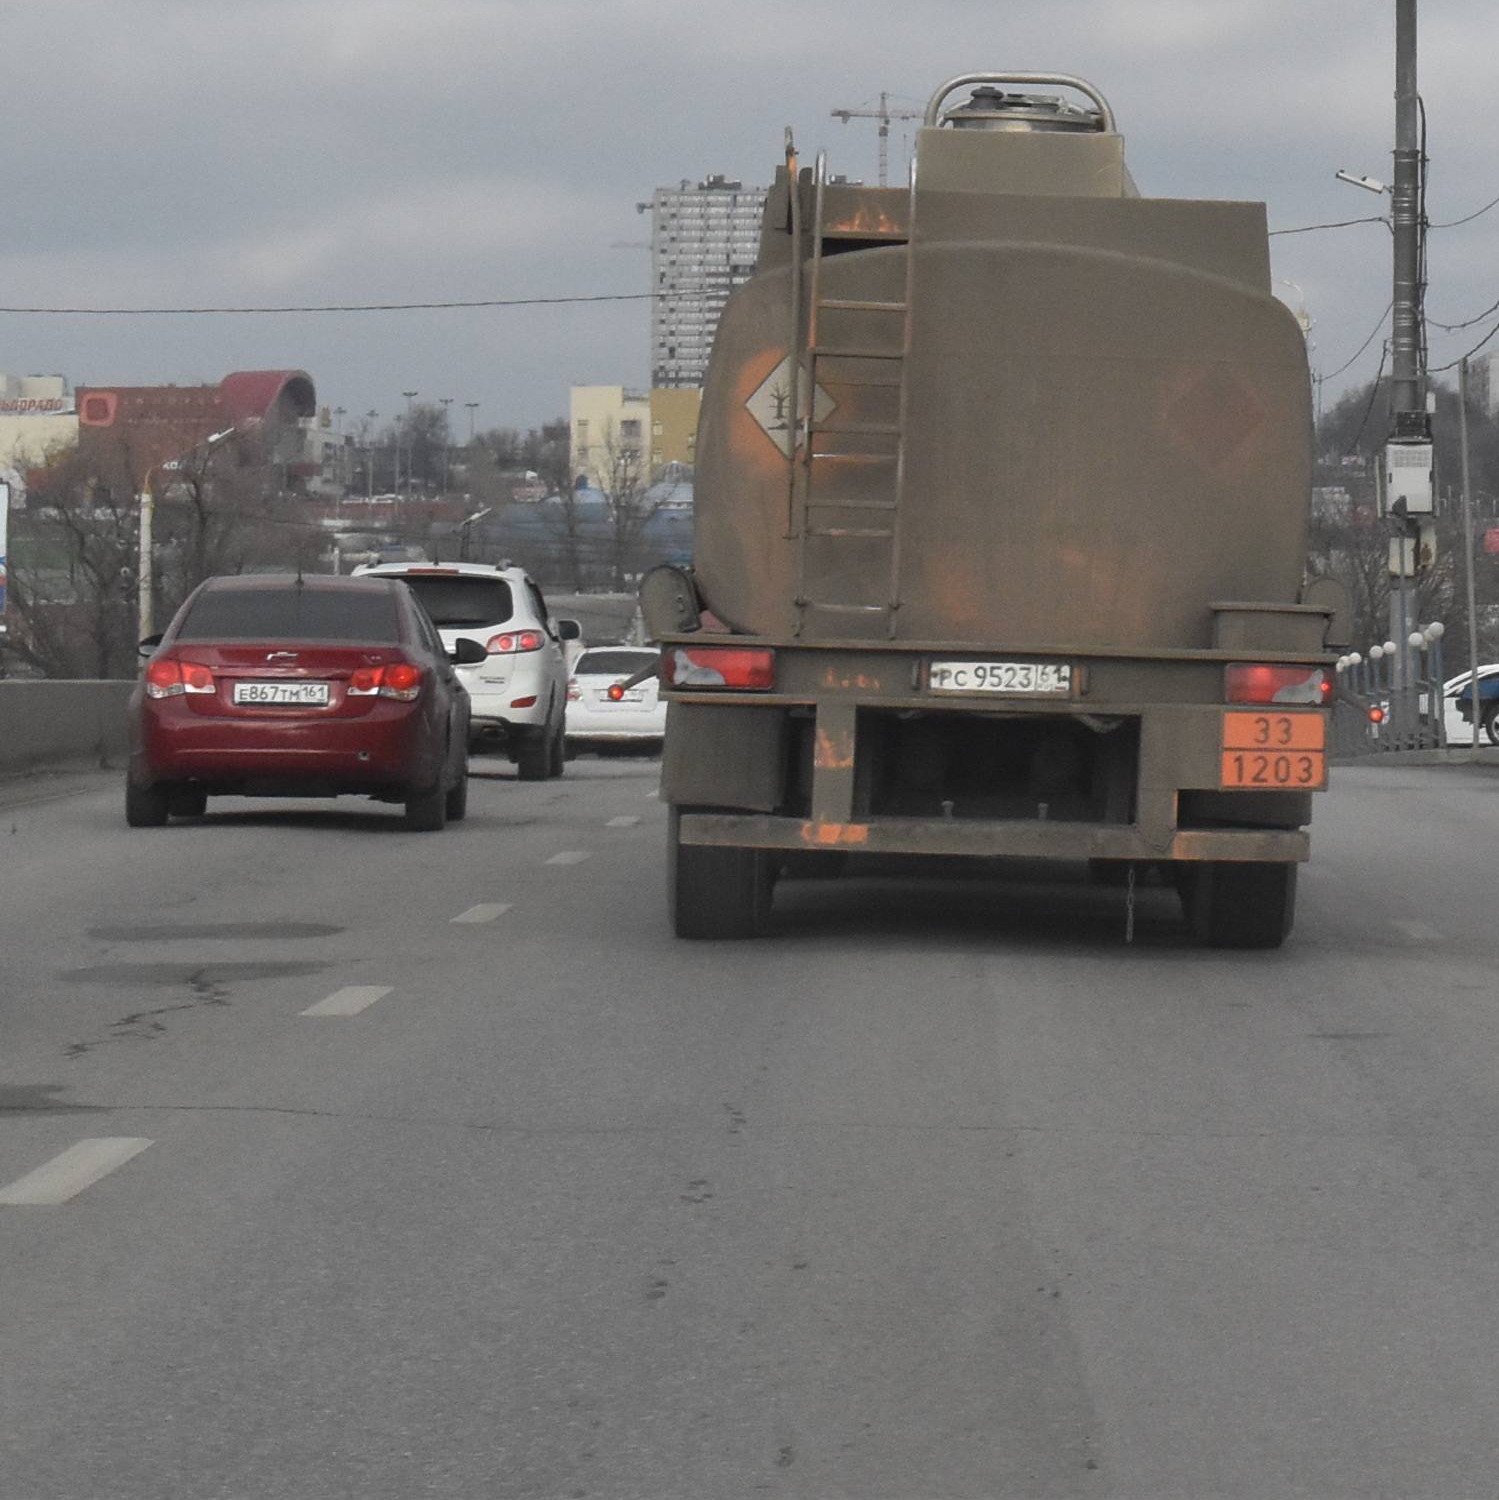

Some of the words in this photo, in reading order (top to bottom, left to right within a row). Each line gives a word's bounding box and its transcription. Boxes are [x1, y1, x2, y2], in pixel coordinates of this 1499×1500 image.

[974, 666, 1032, 689] 9523
[1254, 717, 1293, 745] 33
[1234, 755, 1313, 784] 1203
